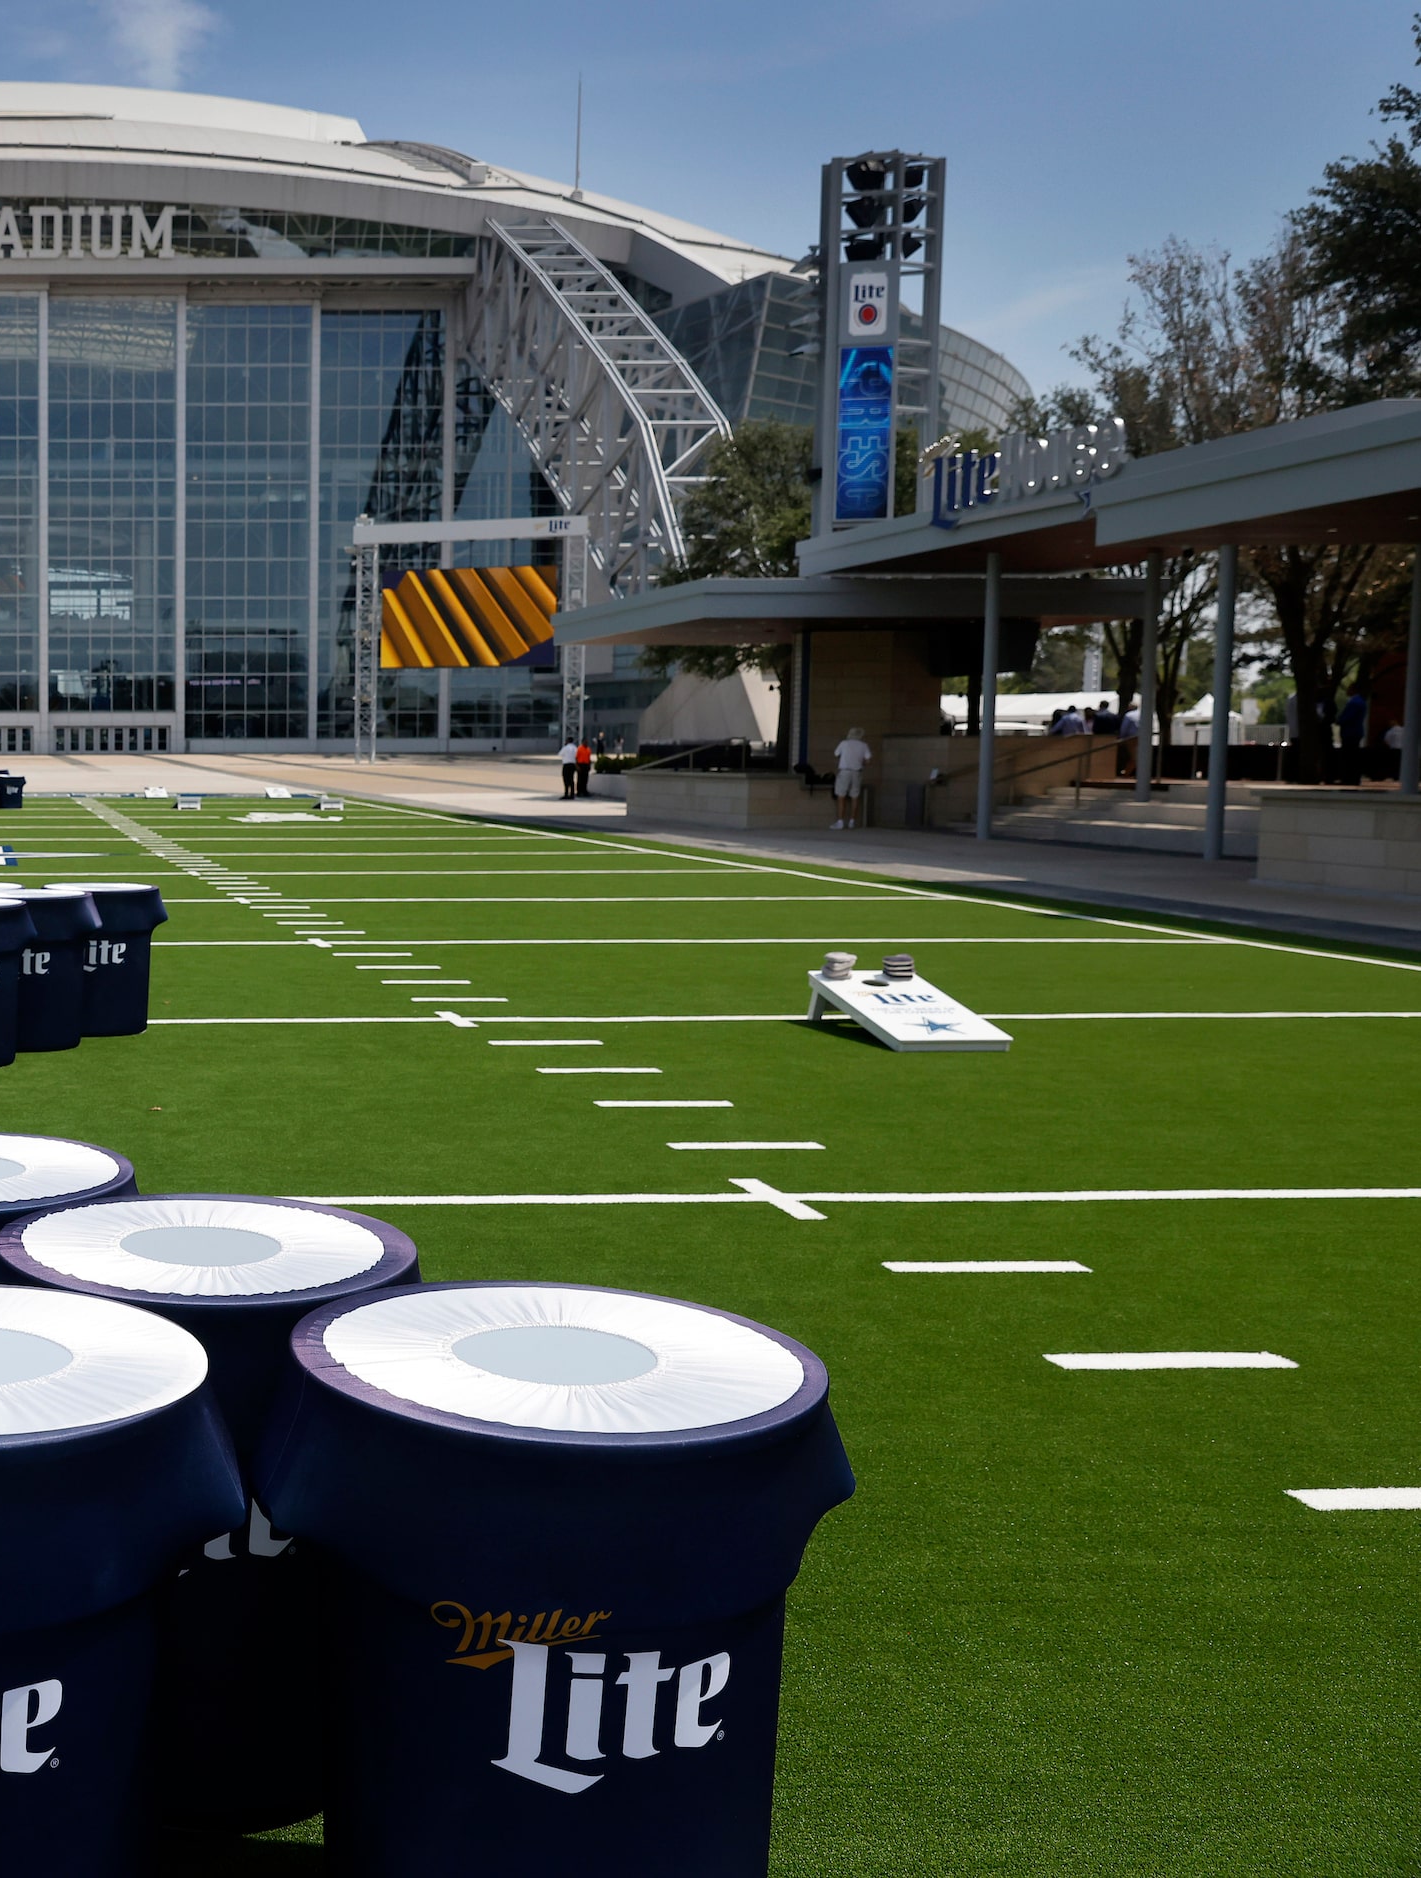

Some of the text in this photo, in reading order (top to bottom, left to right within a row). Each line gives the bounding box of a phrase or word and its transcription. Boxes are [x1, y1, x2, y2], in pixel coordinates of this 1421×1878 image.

[853, 284, 885, 303] Lite
[931, 449, 1001, 529] Lite
[871, 993, 938, 1006] Lite
[430, 1600, 612, 1665] Miller
[490, 1638, 731, 1794] Lite
